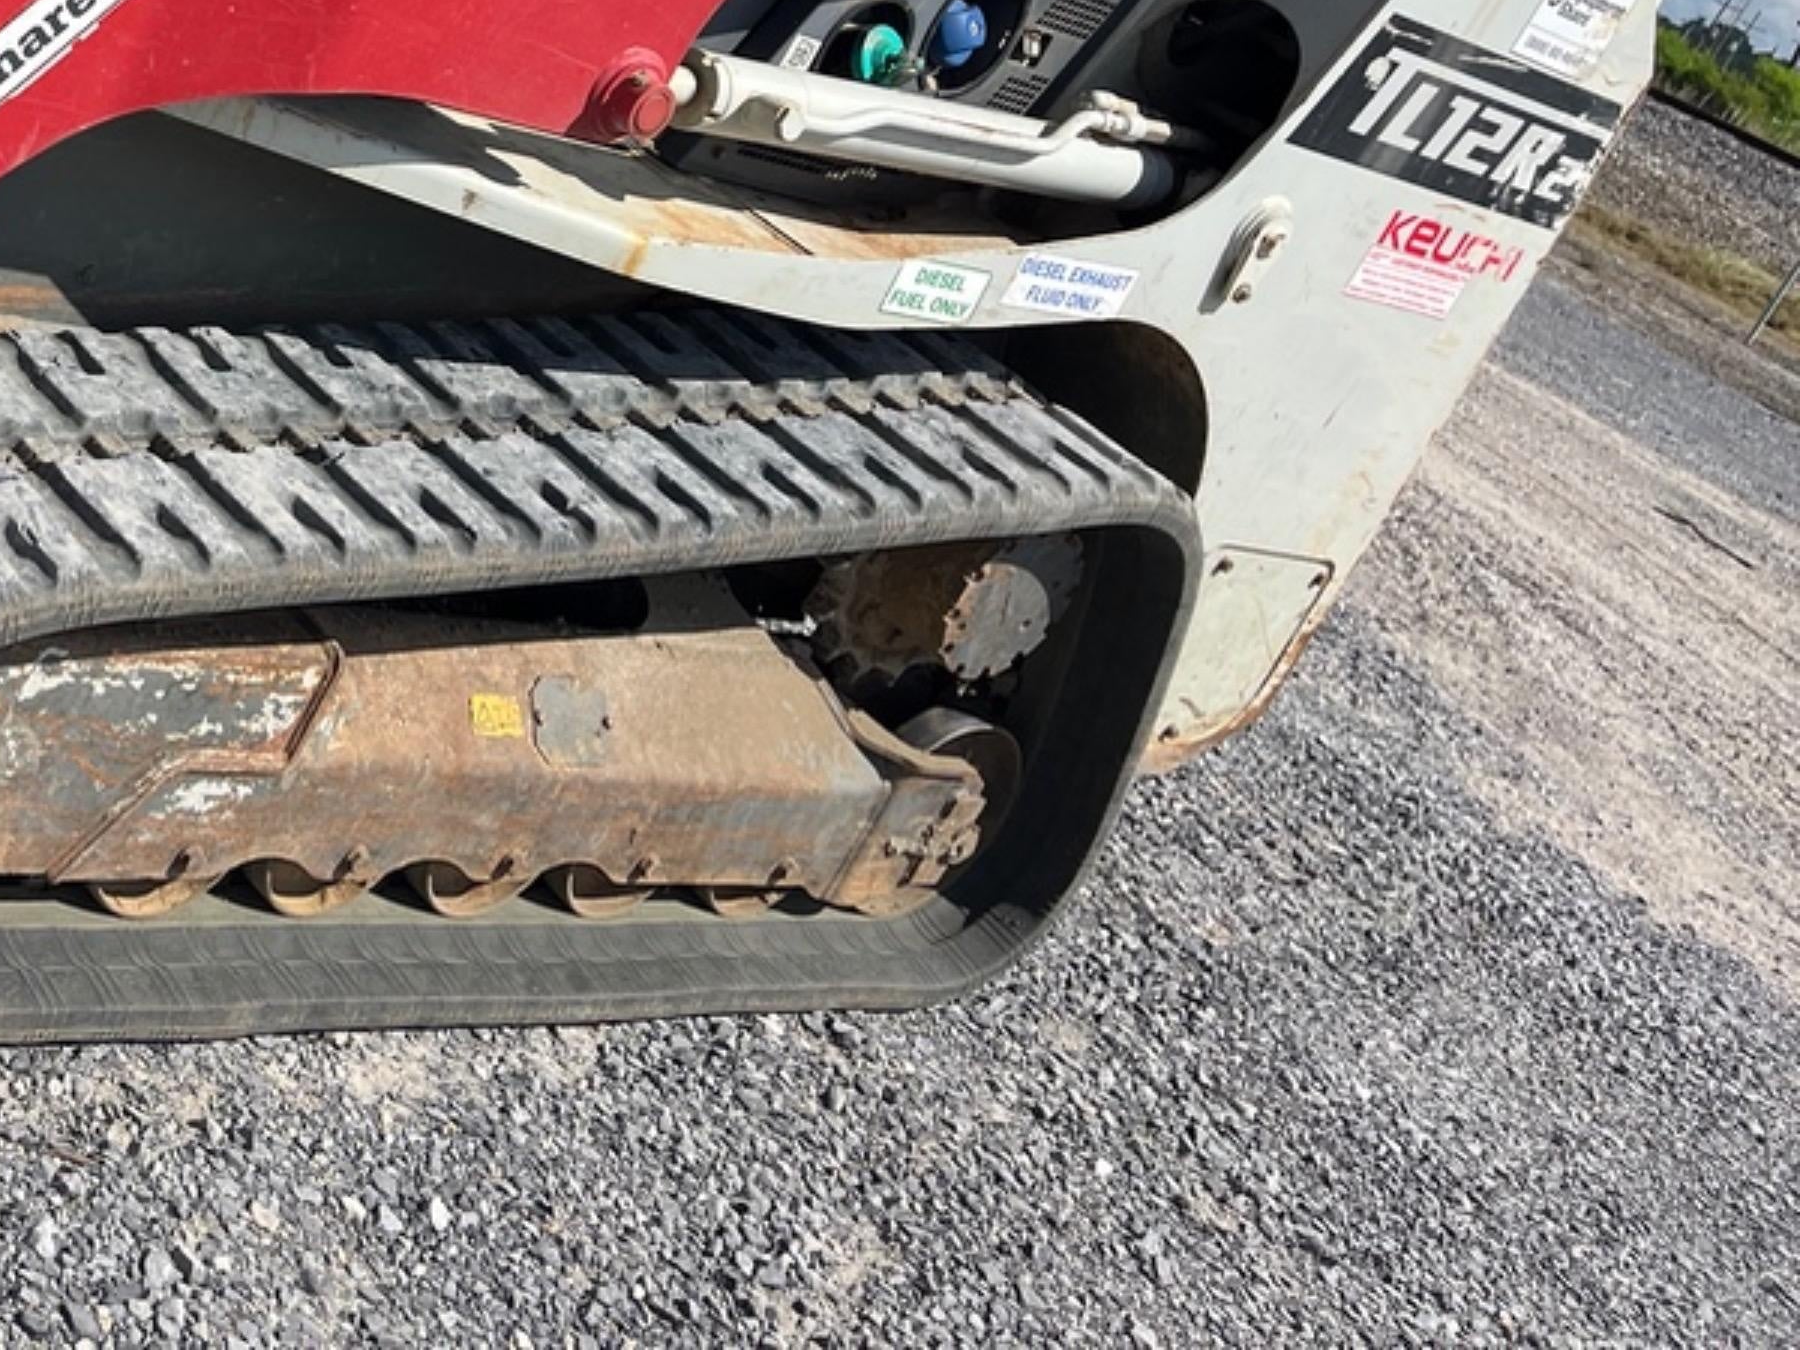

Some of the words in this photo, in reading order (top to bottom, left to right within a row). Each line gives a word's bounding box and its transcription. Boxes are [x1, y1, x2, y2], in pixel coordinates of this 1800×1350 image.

[914, 266, 968, 292] DIESEL
[1020, 257, 1068, 282] DIESEL
[1068, 266, 1133, 292] EXHAUST
[888, 290, 925, 311] FUEL
[929, 297, 970, 317] ONLY
[1025, 284, 1066, 308] FLUID
